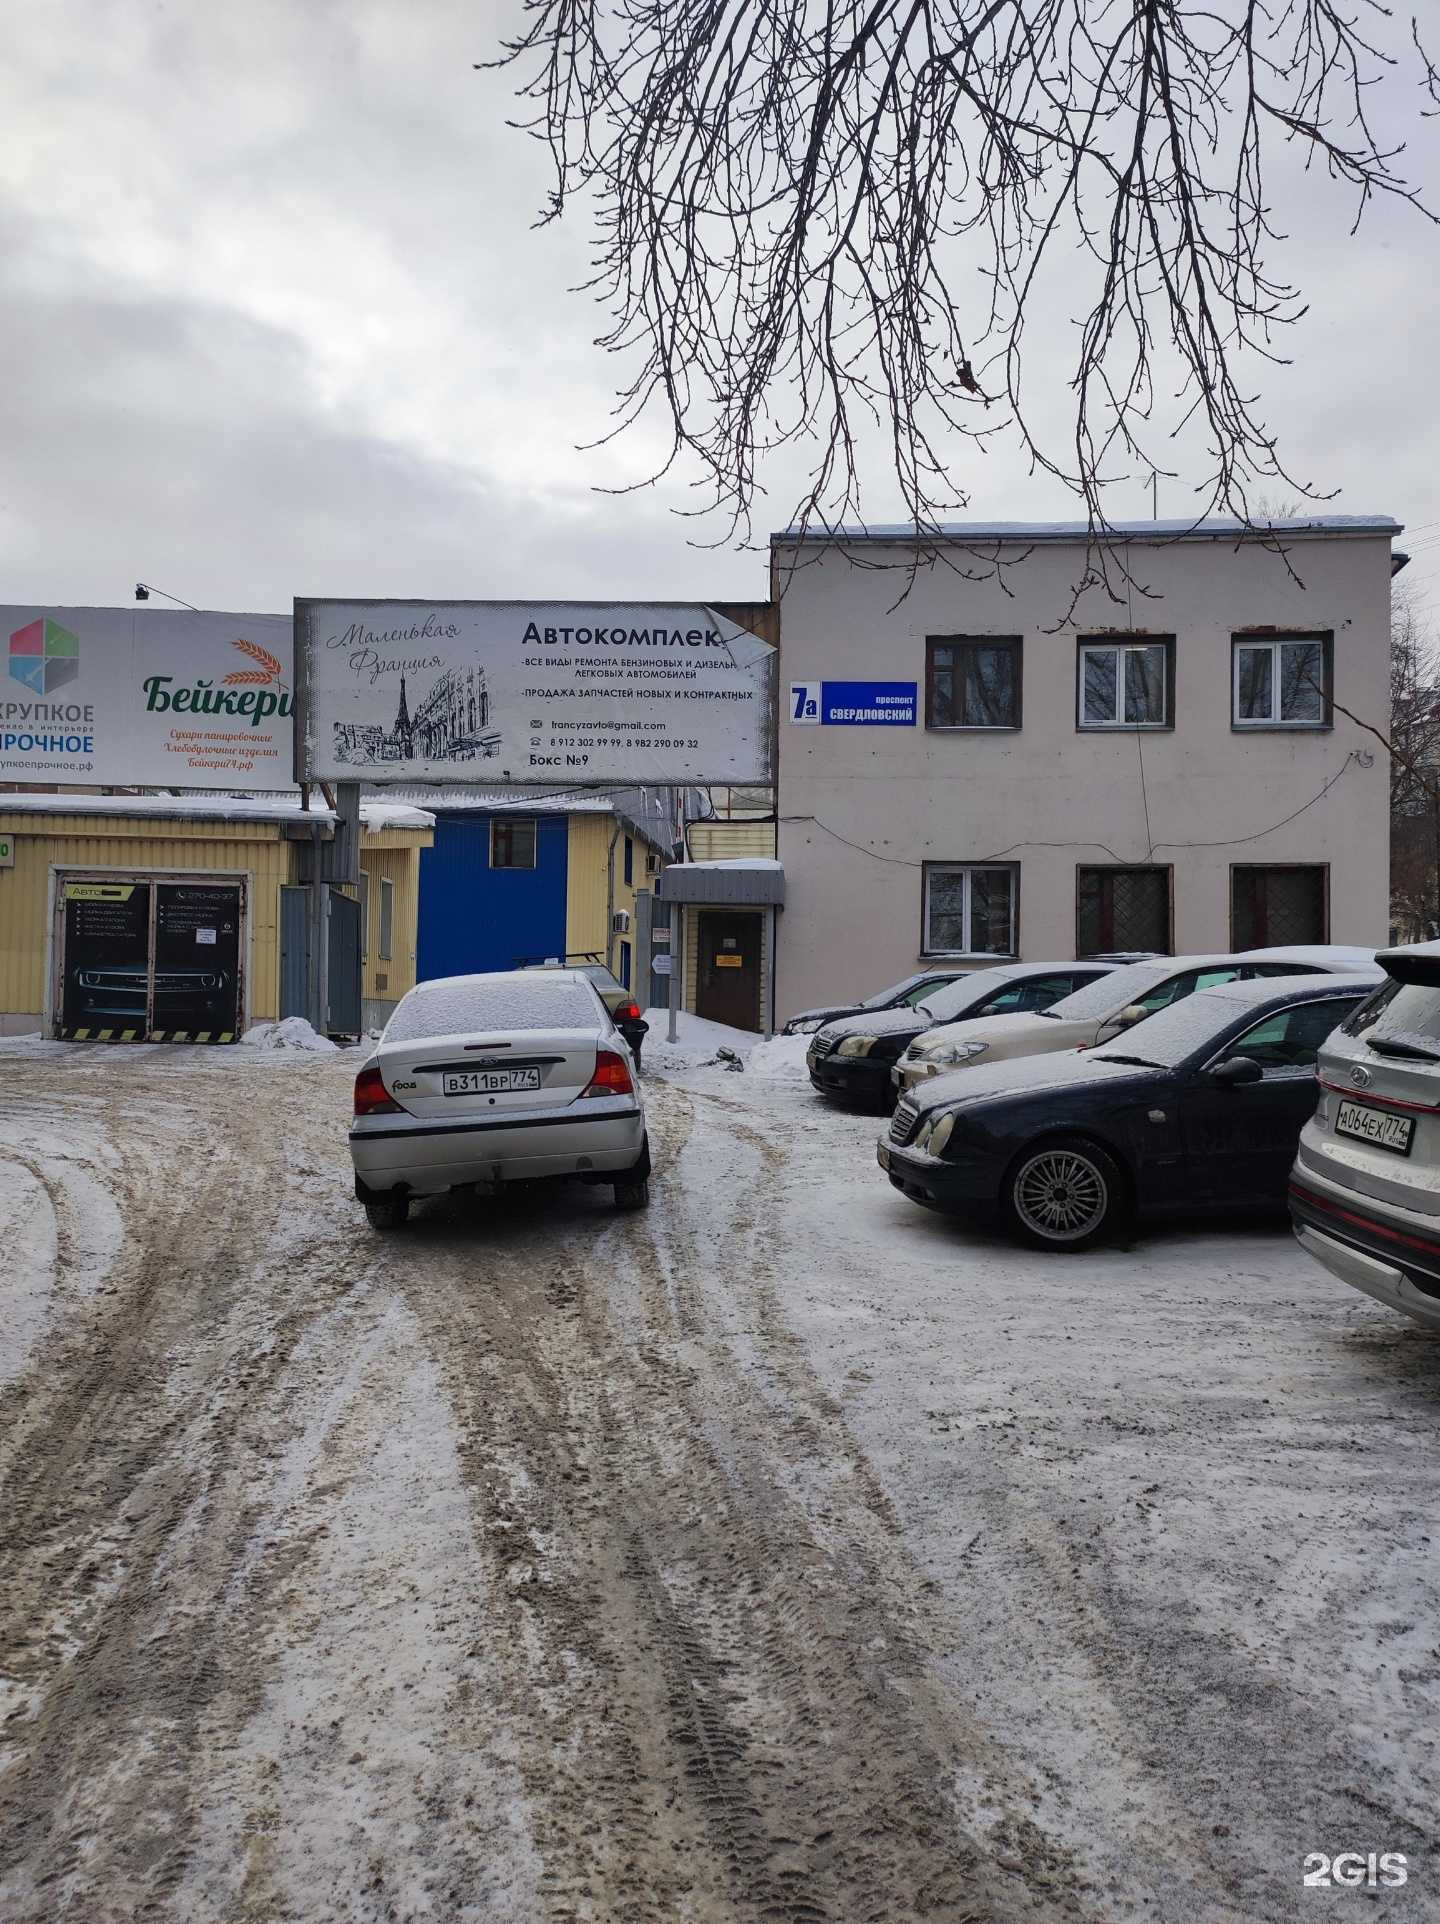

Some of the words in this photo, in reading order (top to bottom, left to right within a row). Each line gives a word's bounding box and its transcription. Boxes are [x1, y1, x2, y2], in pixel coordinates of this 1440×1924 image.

[326, 614, 461, 648] Маленькая
[521, 623, 720, 647] Автокомплек
[349, 648, 445, 684] Франция
[545, 658, 572, 667] ВИДЫ
[574, 658, 618, 667] РЕМОНТА
[621, 659, 683, 668] БЕНЗИНОВЫХ
[686, 660, 692, 668] И
[694, 660, 738, 669] ДИЗЕЛЬН
[574, 669, 623, 678] ЛЕГКОВЫХ
[626, 669, 697, 679] АВТОМОБИЛЕЙ
[142, 676, 293, 726] Бейкери
[578, 688, 634, 698] ЗАПЧАСТЕЙ
[636, 689, 671, 698] НОВЫХ
[675, 690, 681, 699] И
[684, 690, 753, 700] КОНТРАКТНЫХ
[875, 696, 913, 705] проспект
[791, 687, 817, 719] 7а
[0, 703, 94, 722] РУПКОЕ
[829, 707, 913, 721] СВЕРДЛОВСКИЙ
[40, 724, 94, 733] интерьере
[170, 729, 203, 742] Сухари
[204, 730, 273, 743] панировочные
[550, 738, 556, 747] 8
[558, 738, 575, 747] 912
[577, 738, 594, 747] 302
[597, 738, 607, 747] 99
[626, 739, 632, 748] 8
[635, 739, 651, 748] 982
[654, 739, 671, 748] 290
[673, 739, 684, 748] 09
[687, 739, 698, 748] 32
[164, 743, 237, 755] Хлебобулочные
[239, 747, 278, 758] изделия
[187, 757, 254, 771] Бейкери74.рф
[529, 754, 561, 766] Бокс
[566, 754, 589, 766] №9
[449, 1073, 508, 1090] В311ВР
[511, 1070, 537, 1083] 774
[1340, 1108, 1384, 1139] А064ЕХ
[1386, 1116, 1407, 1138] 774
